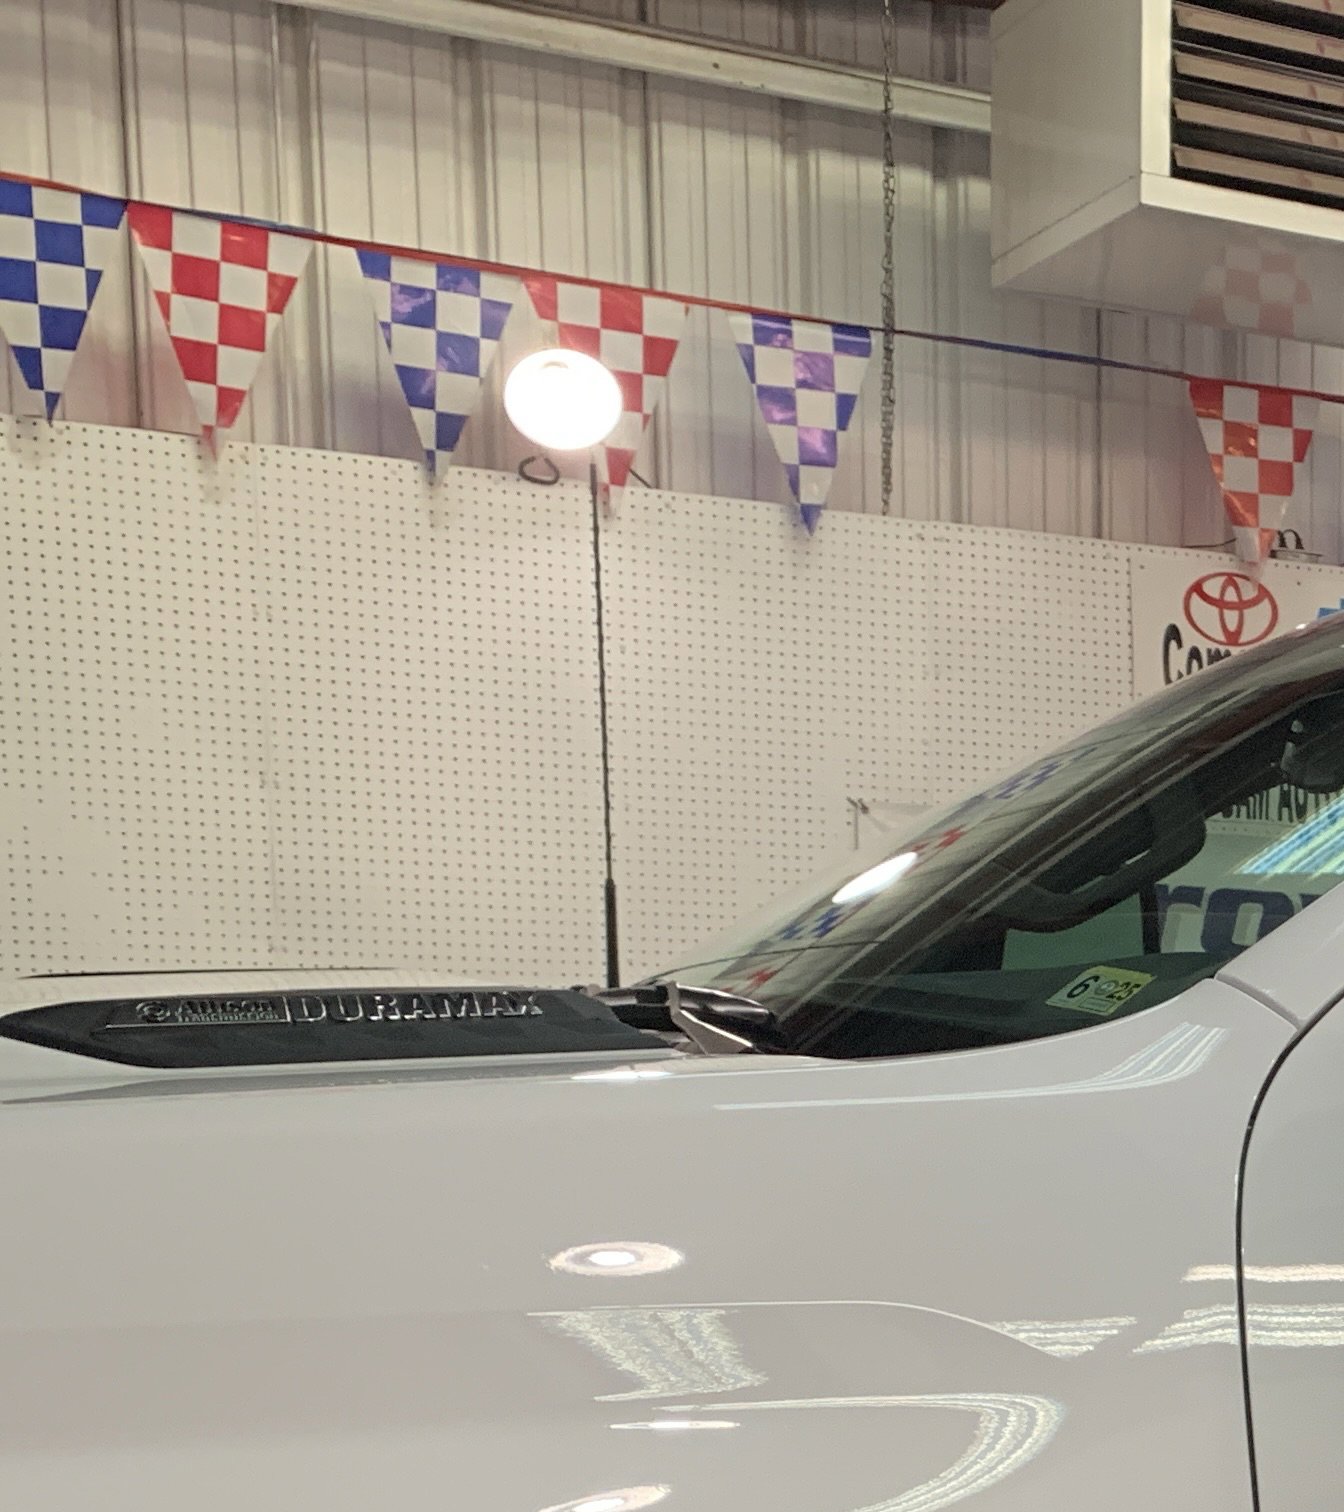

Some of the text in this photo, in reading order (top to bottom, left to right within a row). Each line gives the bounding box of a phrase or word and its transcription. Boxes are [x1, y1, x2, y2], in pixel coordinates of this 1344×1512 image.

[1067, 975, 1142, 1001] 6 25
[295, 992, 543, 1021] DURAMAX
